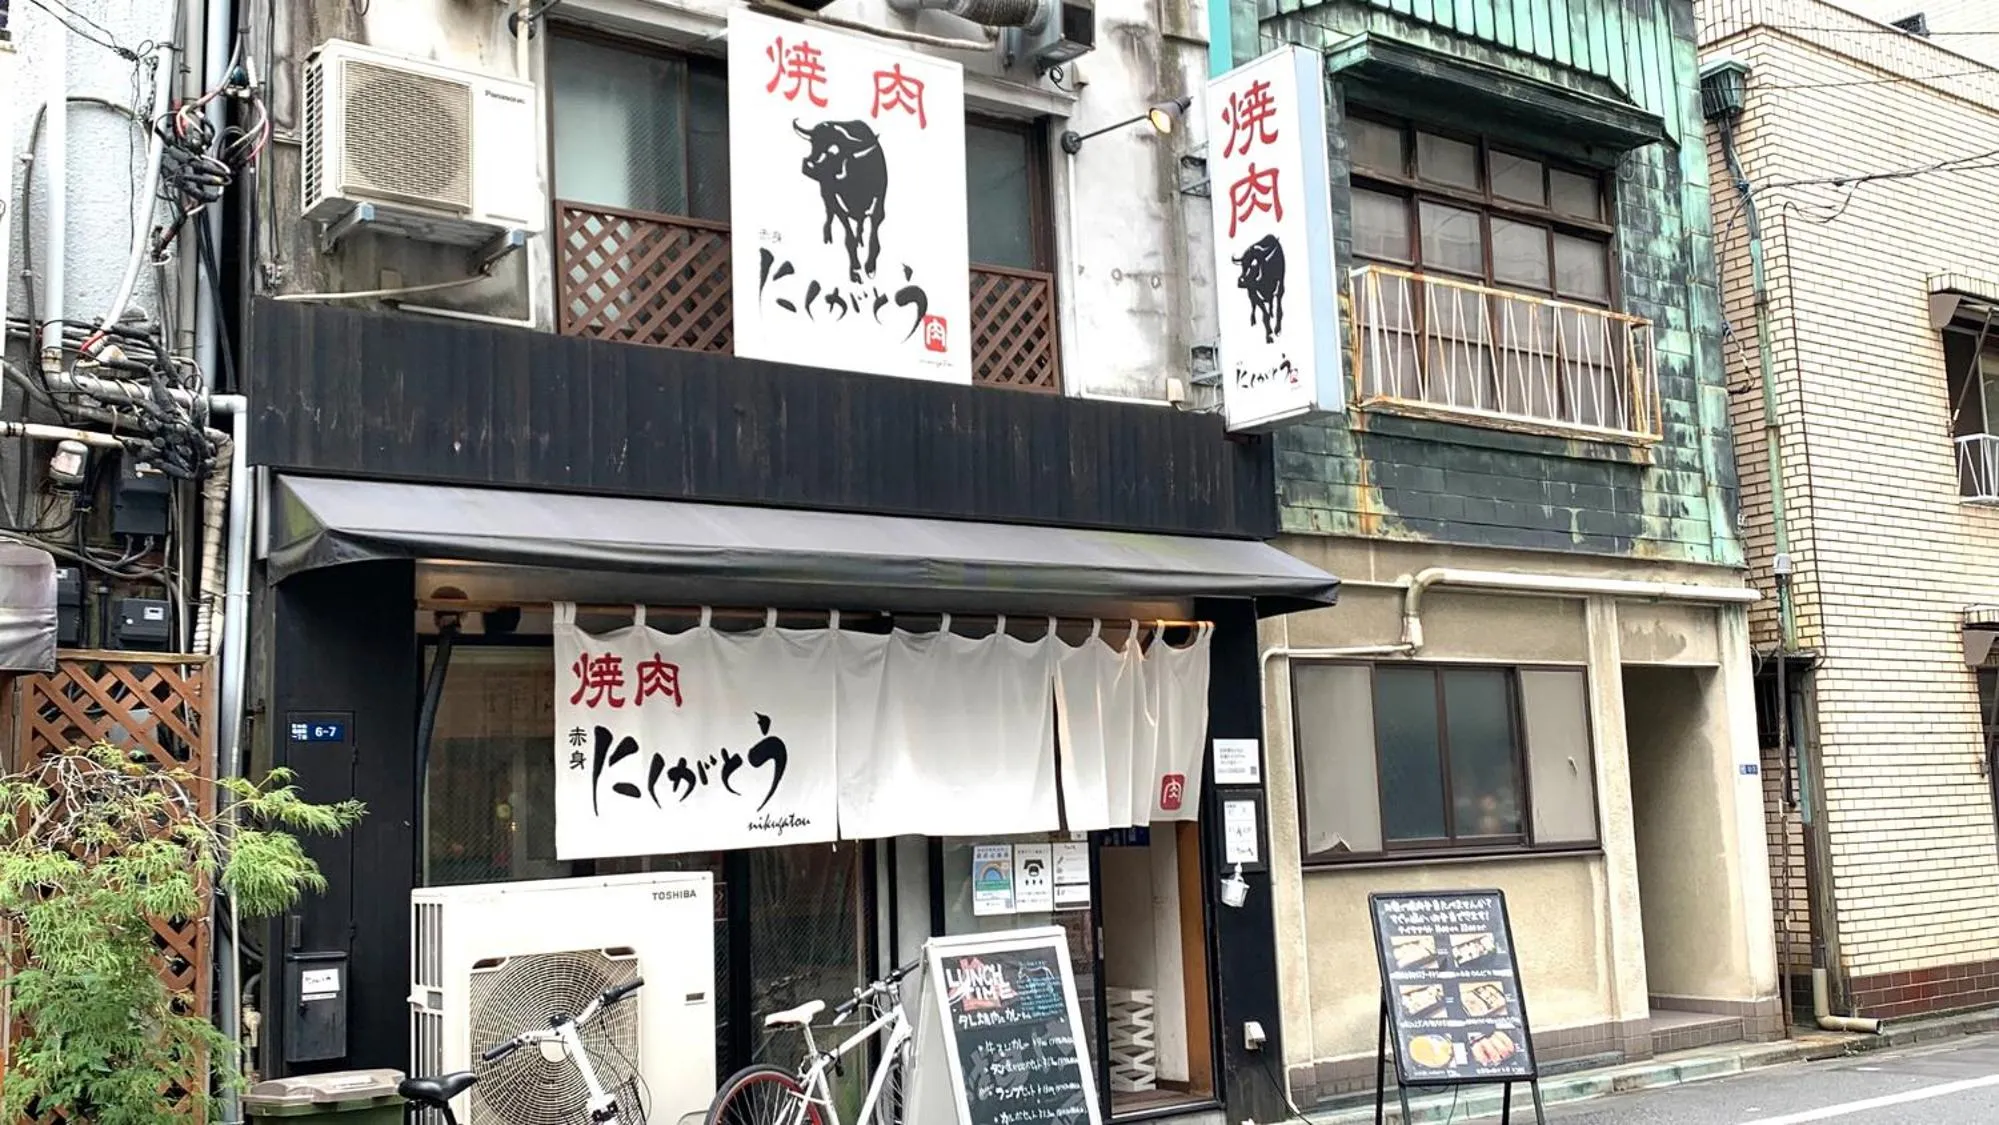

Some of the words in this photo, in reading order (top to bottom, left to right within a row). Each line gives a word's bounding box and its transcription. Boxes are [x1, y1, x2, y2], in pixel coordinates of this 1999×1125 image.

[766, 36, 927, 129] 焼肉
[1222, 81, 1283, 238] 焼肉
[759, 247, 928, 343] にくがとう
[570, 652, 683, 708] 焼肉
[315, 726, 336, 737] 6-7
[568, 727, 588, 770] 赤身
[592, 712, 787, 817] にくがとう
[748, 814, 811, 836] nikugatou
[652, 889, 697, 901] TOSHIBA
[945, 963, 1006, 988] LUNCH
